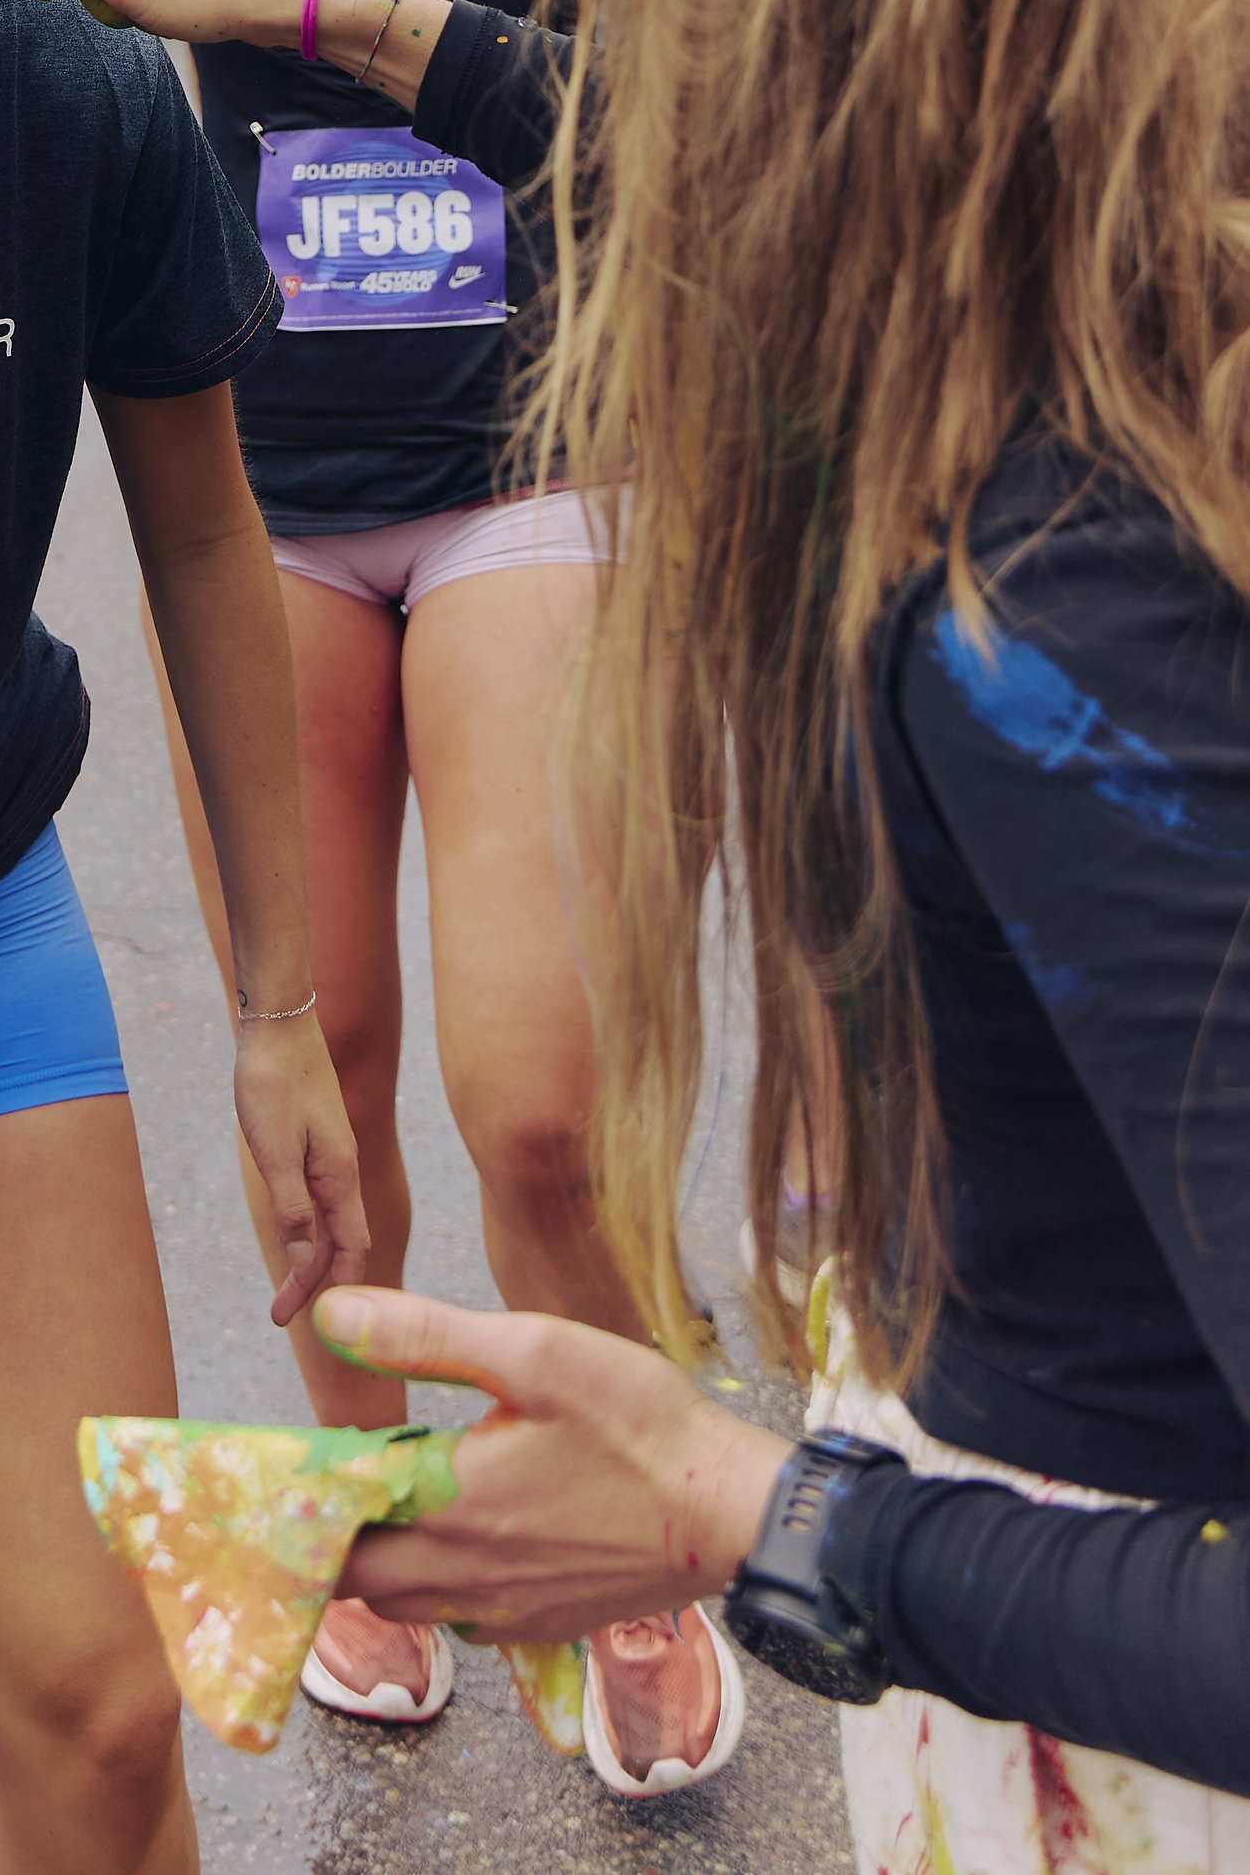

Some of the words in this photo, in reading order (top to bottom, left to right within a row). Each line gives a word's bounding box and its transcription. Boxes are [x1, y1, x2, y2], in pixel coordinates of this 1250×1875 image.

[291, 158, 458, 182] BOLDERBOULDER
[286, 190, 474, 261] JF586
[360, 271, 395, 294] 45
